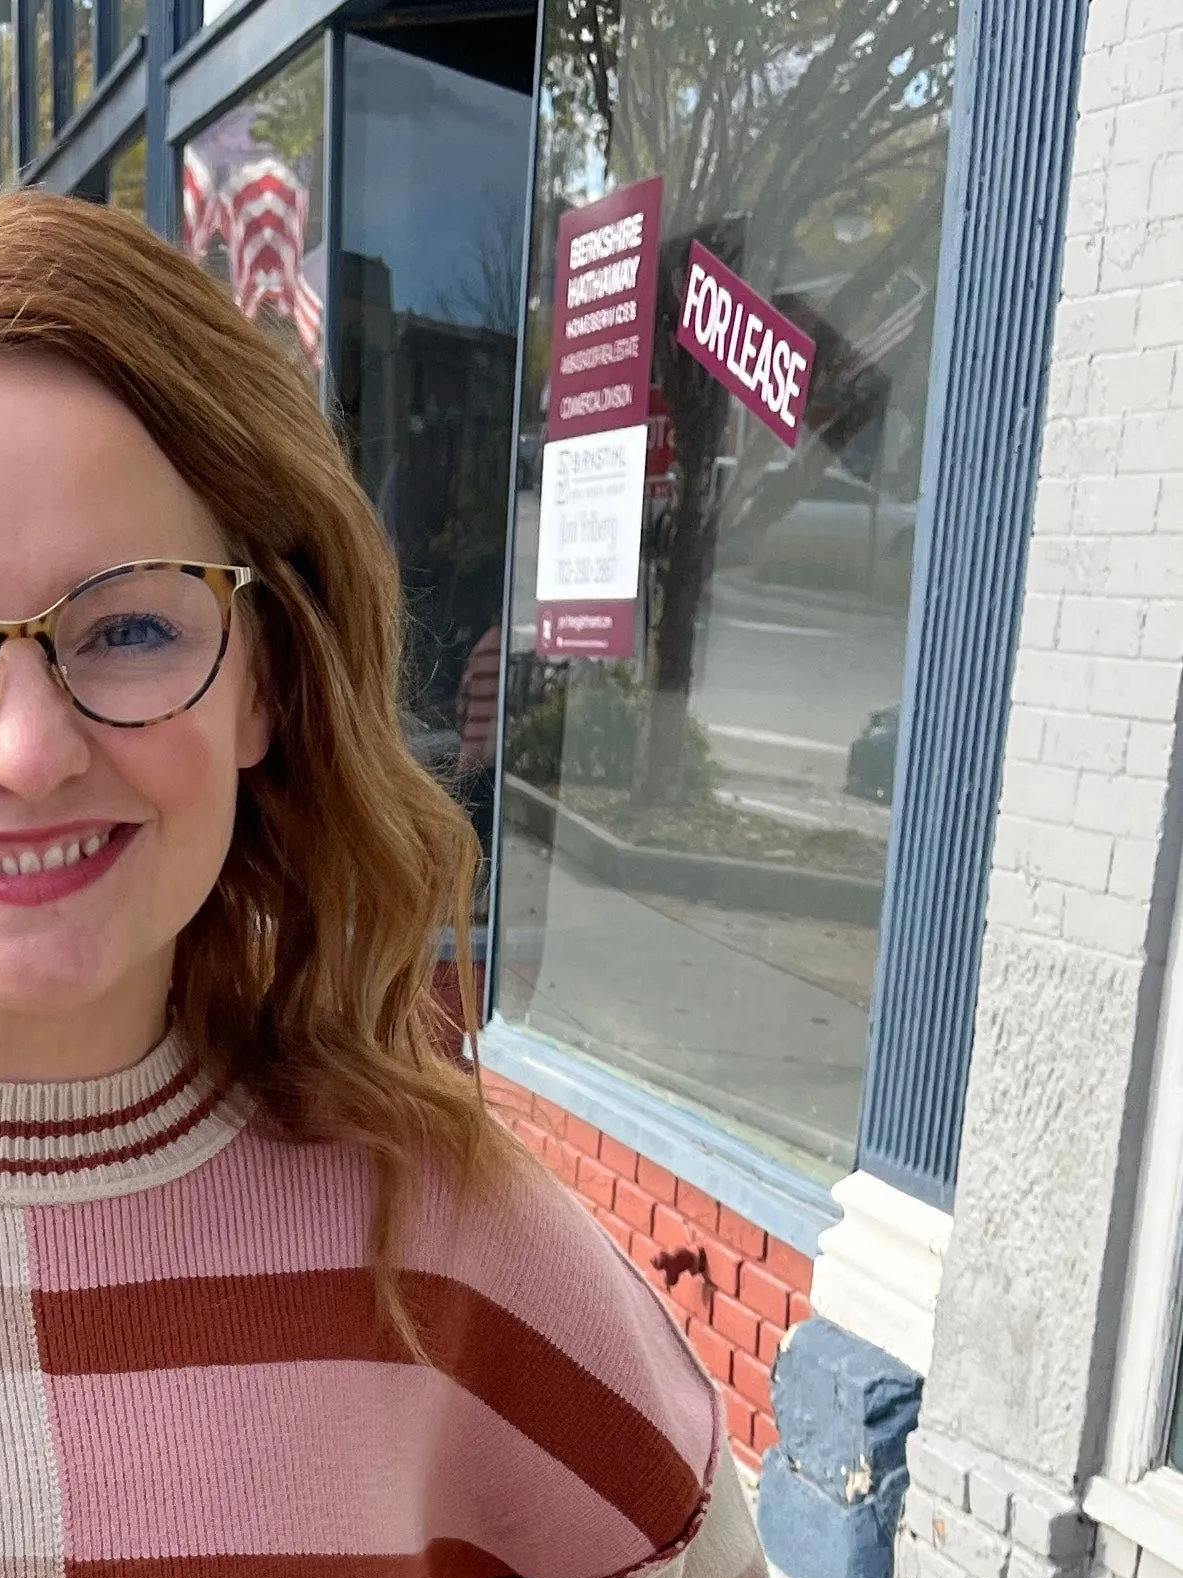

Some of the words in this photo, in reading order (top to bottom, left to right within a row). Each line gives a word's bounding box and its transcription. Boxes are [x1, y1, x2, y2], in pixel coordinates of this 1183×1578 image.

[569, 212, 644, 270] BERKSHIRE
[682, 263, 733, 361] FOR
[727, 302, 807, 428] LEASE
